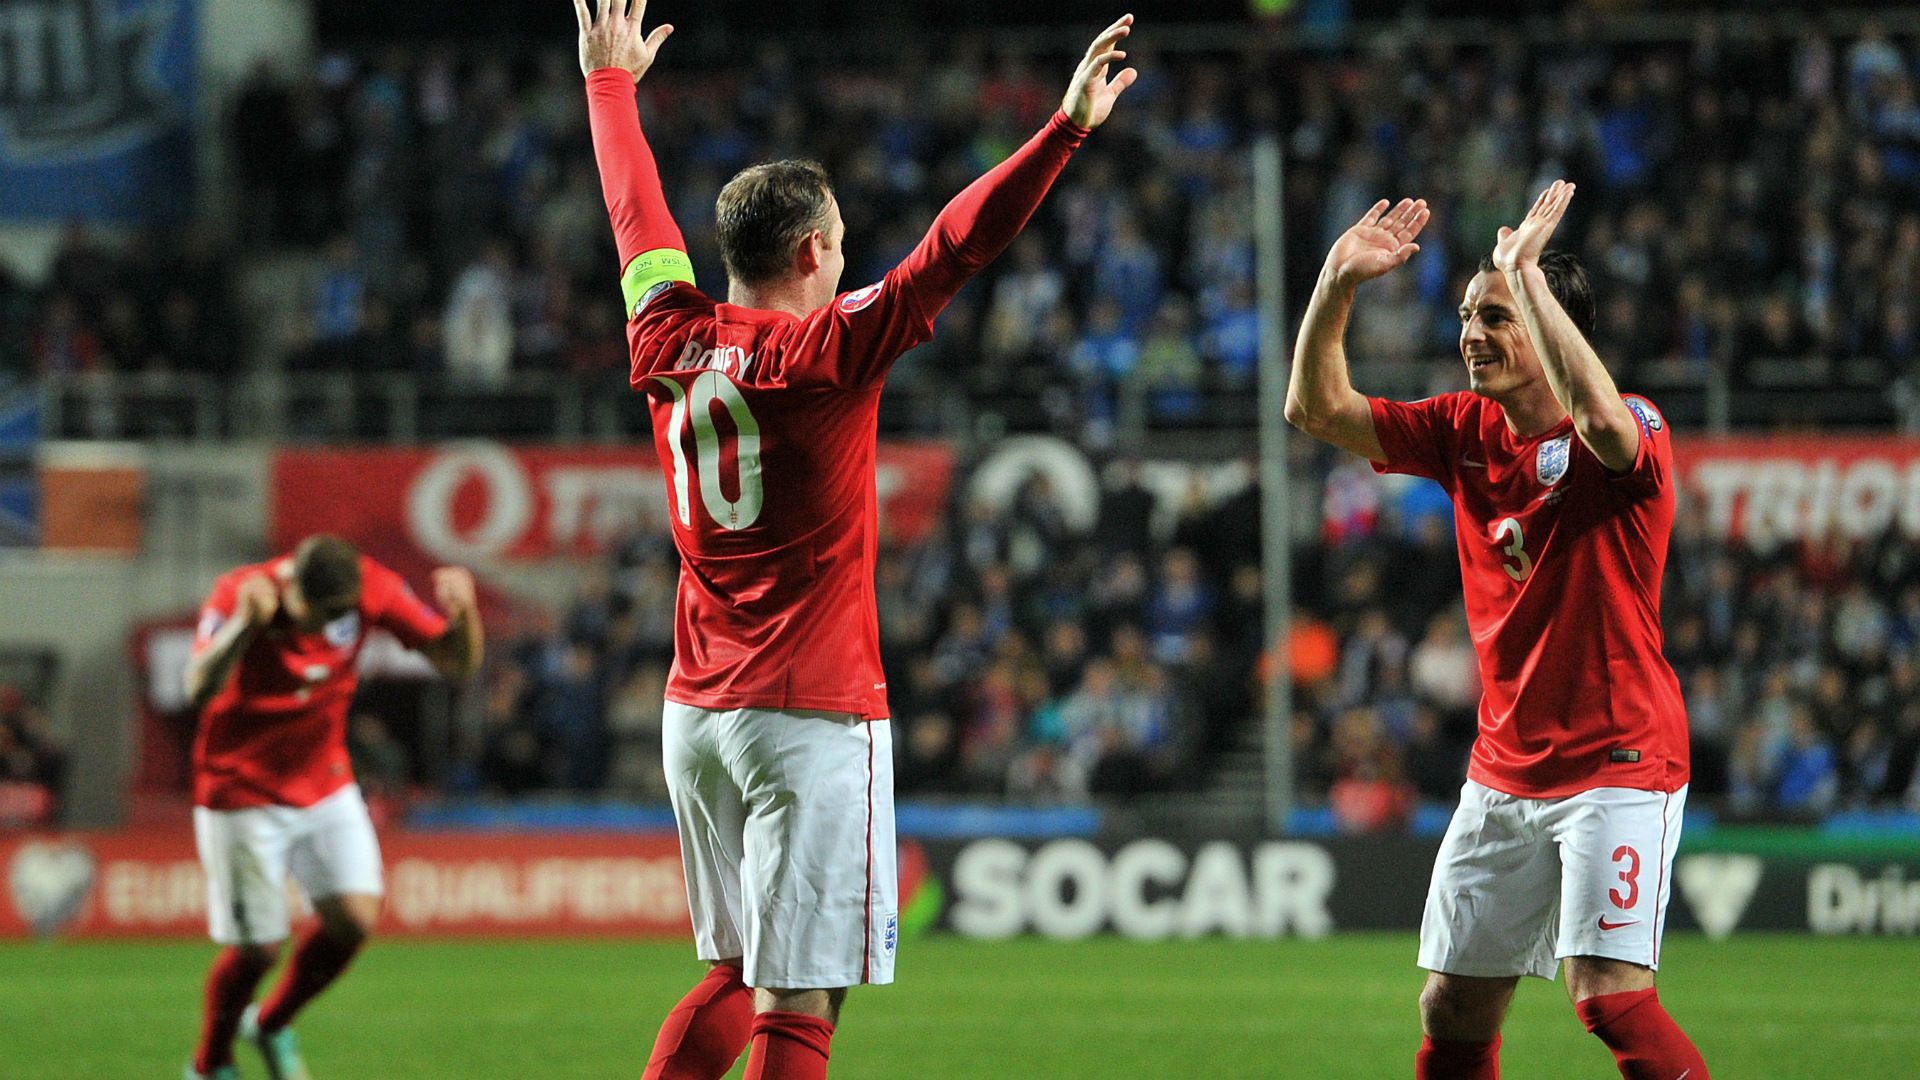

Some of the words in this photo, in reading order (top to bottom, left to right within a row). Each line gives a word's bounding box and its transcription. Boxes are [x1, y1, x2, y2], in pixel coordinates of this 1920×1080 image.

[645, 369, 764, 531] 10
[1495, 517, 1532, 582] 3
[952, 838, 1336, 940] SOCAR
[1609, 845, 1640, 910] 3
